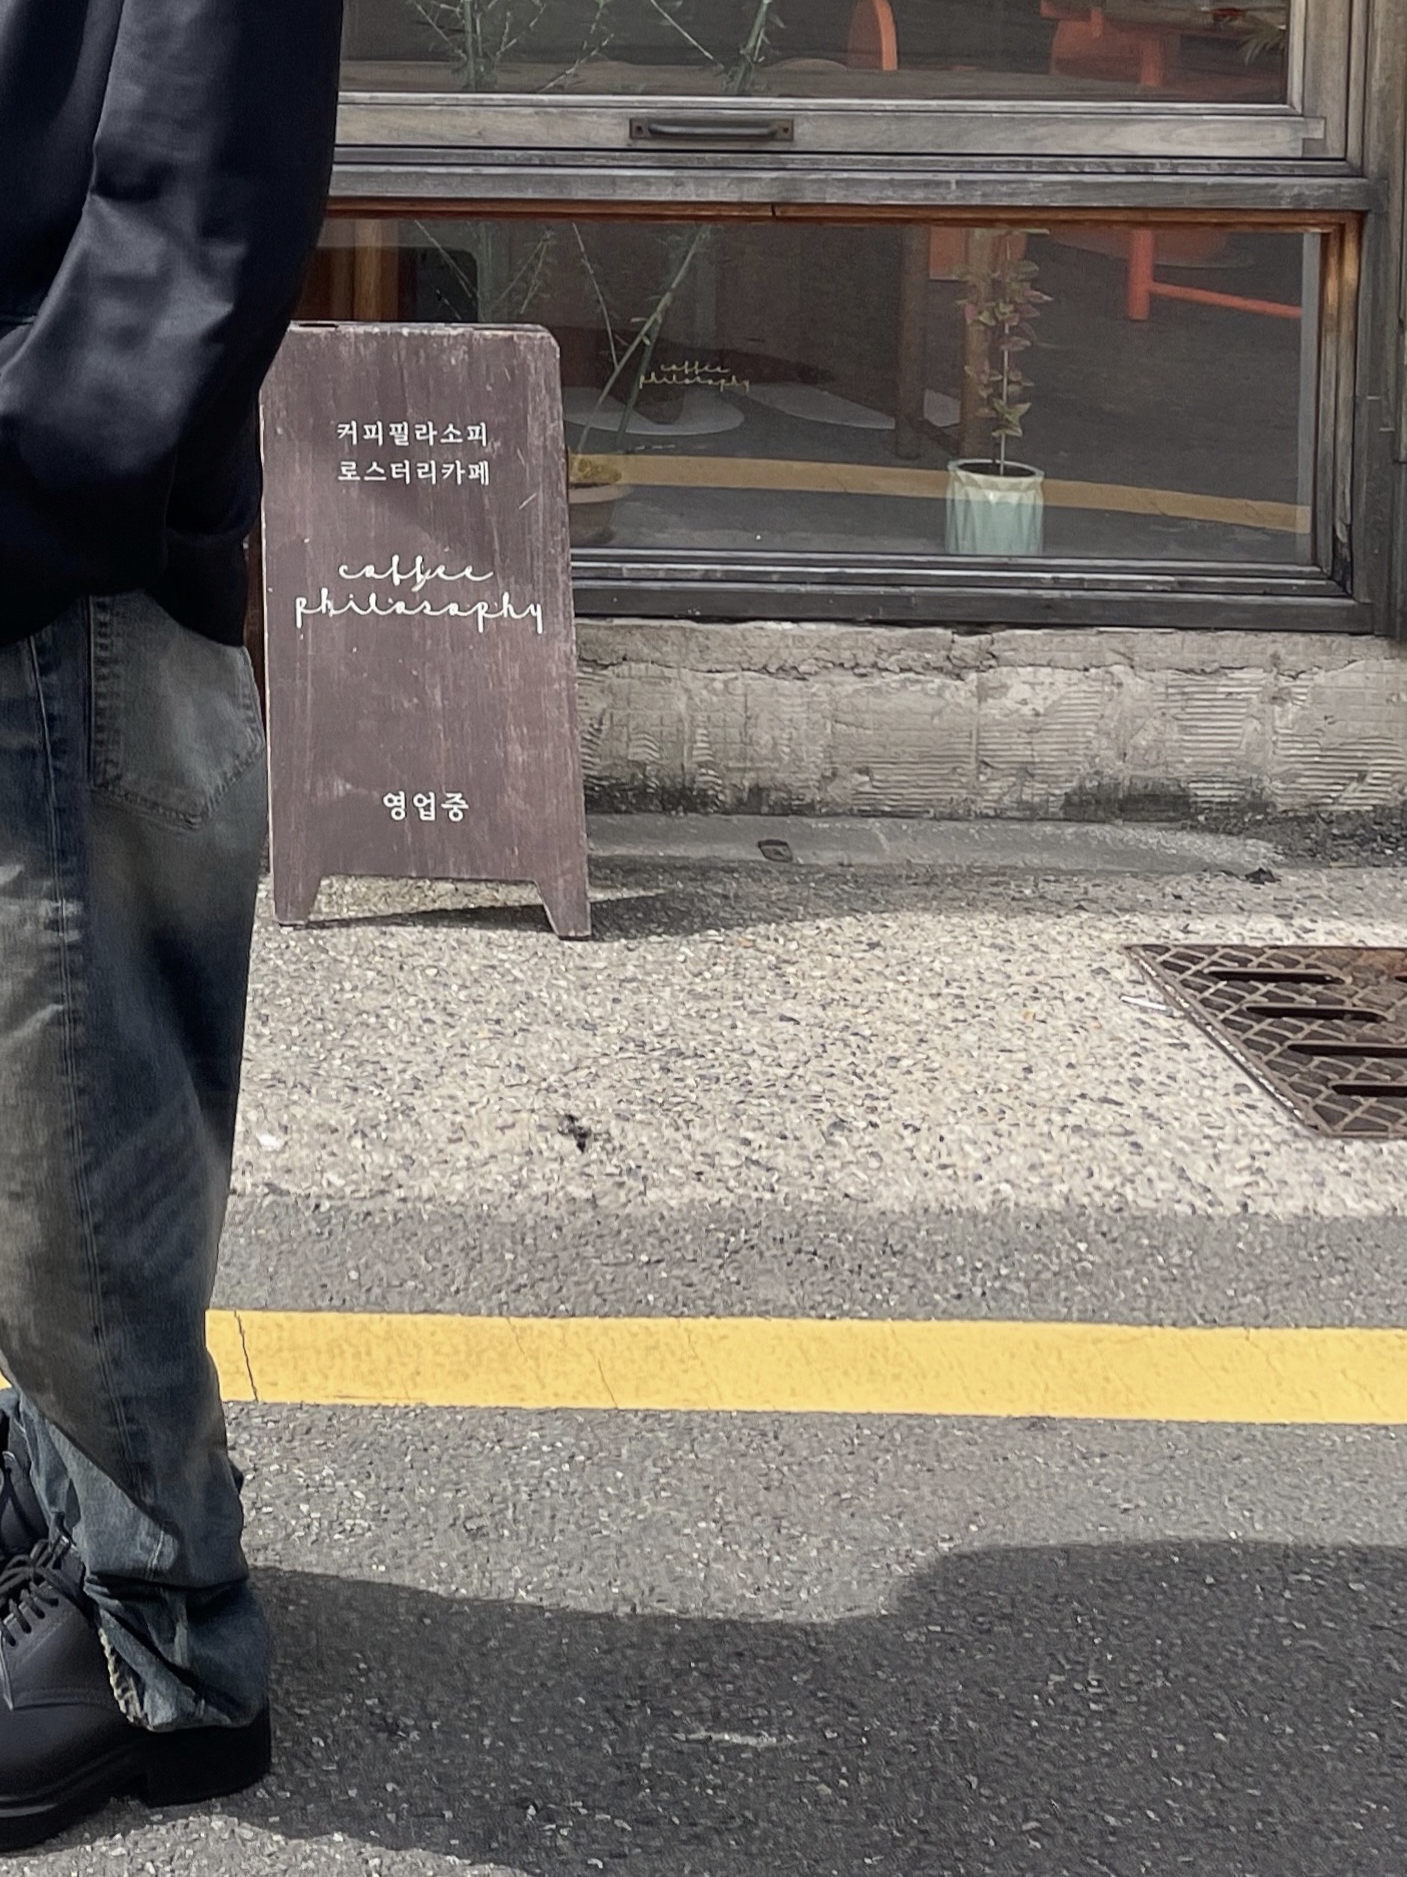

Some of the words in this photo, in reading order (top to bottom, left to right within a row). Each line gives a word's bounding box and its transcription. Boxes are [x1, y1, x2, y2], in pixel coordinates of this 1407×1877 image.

[660, 360, 732, 375] coffee
[638, 371, 751, 393] philosophy
[336, 420, 488, 447] 커피필라소피
[336, 459, 490, 486] 로스터리카페
[338, 554, 494, 592] coffee
[294, 587, 543, 635] philosophy
[382, 790, 470, 822] 영업중
